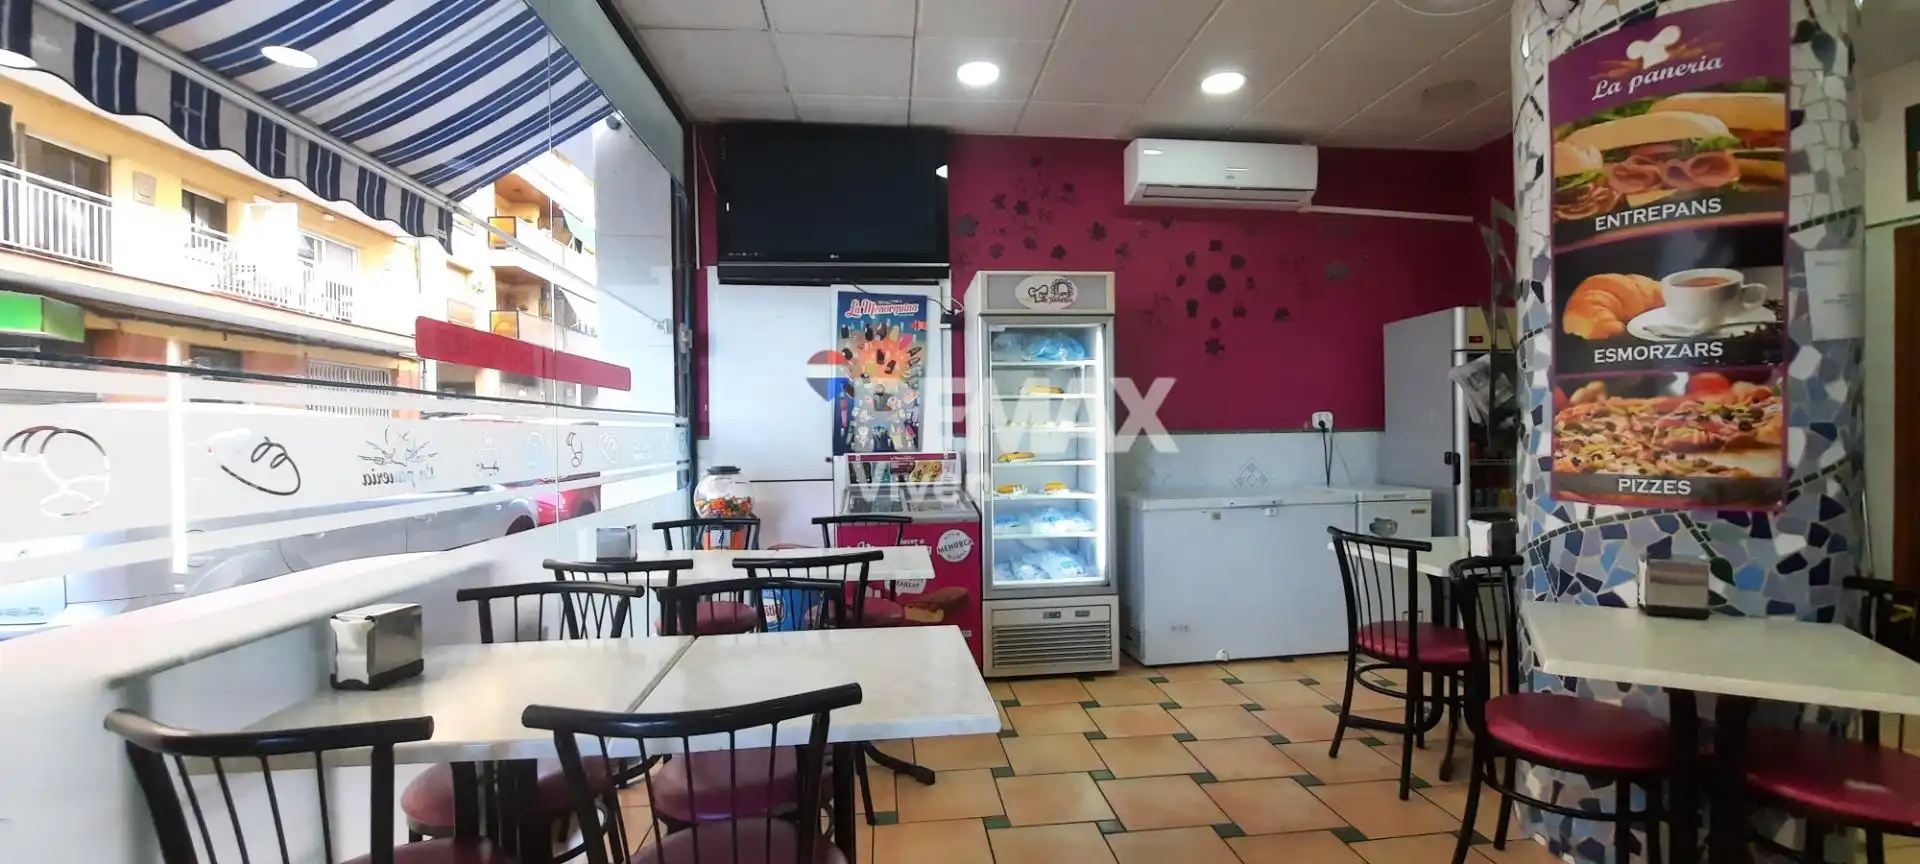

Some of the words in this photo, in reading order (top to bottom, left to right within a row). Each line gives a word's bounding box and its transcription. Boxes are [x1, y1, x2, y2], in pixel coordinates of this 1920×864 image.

[1591, 79, 1621, 100] La
[1628, 56, 1723, 94] paneria
[1595, 197, 1722, 231] ENTREPANS
[1594, 341, 1724, 363] ESMORZARS
[1618, 478, 1692, 495] PIZZES
